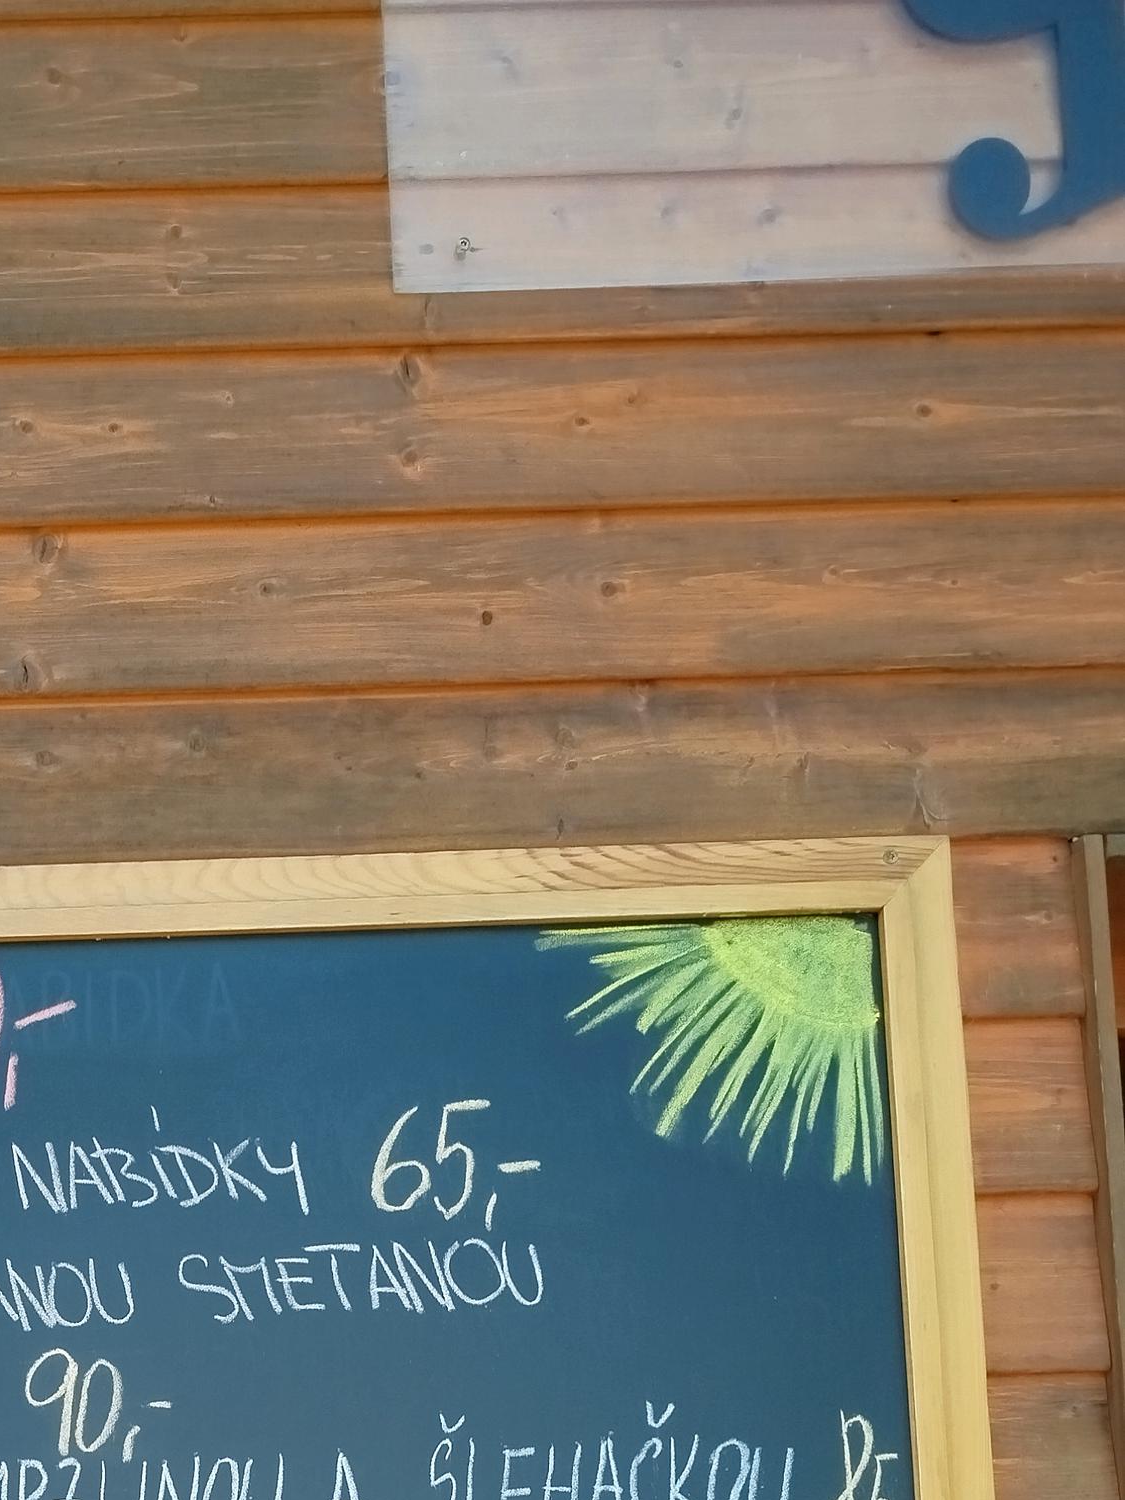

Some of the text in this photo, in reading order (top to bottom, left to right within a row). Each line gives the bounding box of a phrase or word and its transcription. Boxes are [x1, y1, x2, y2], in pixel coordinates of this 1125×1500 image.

[12, 1106, 309, 1216] NABÍDKY
[370, 1099, 541, 1231] 65,-
[178, 1237, 544, 1325] SMETANOU
[25, 1348, 172, 1463] 90,-
